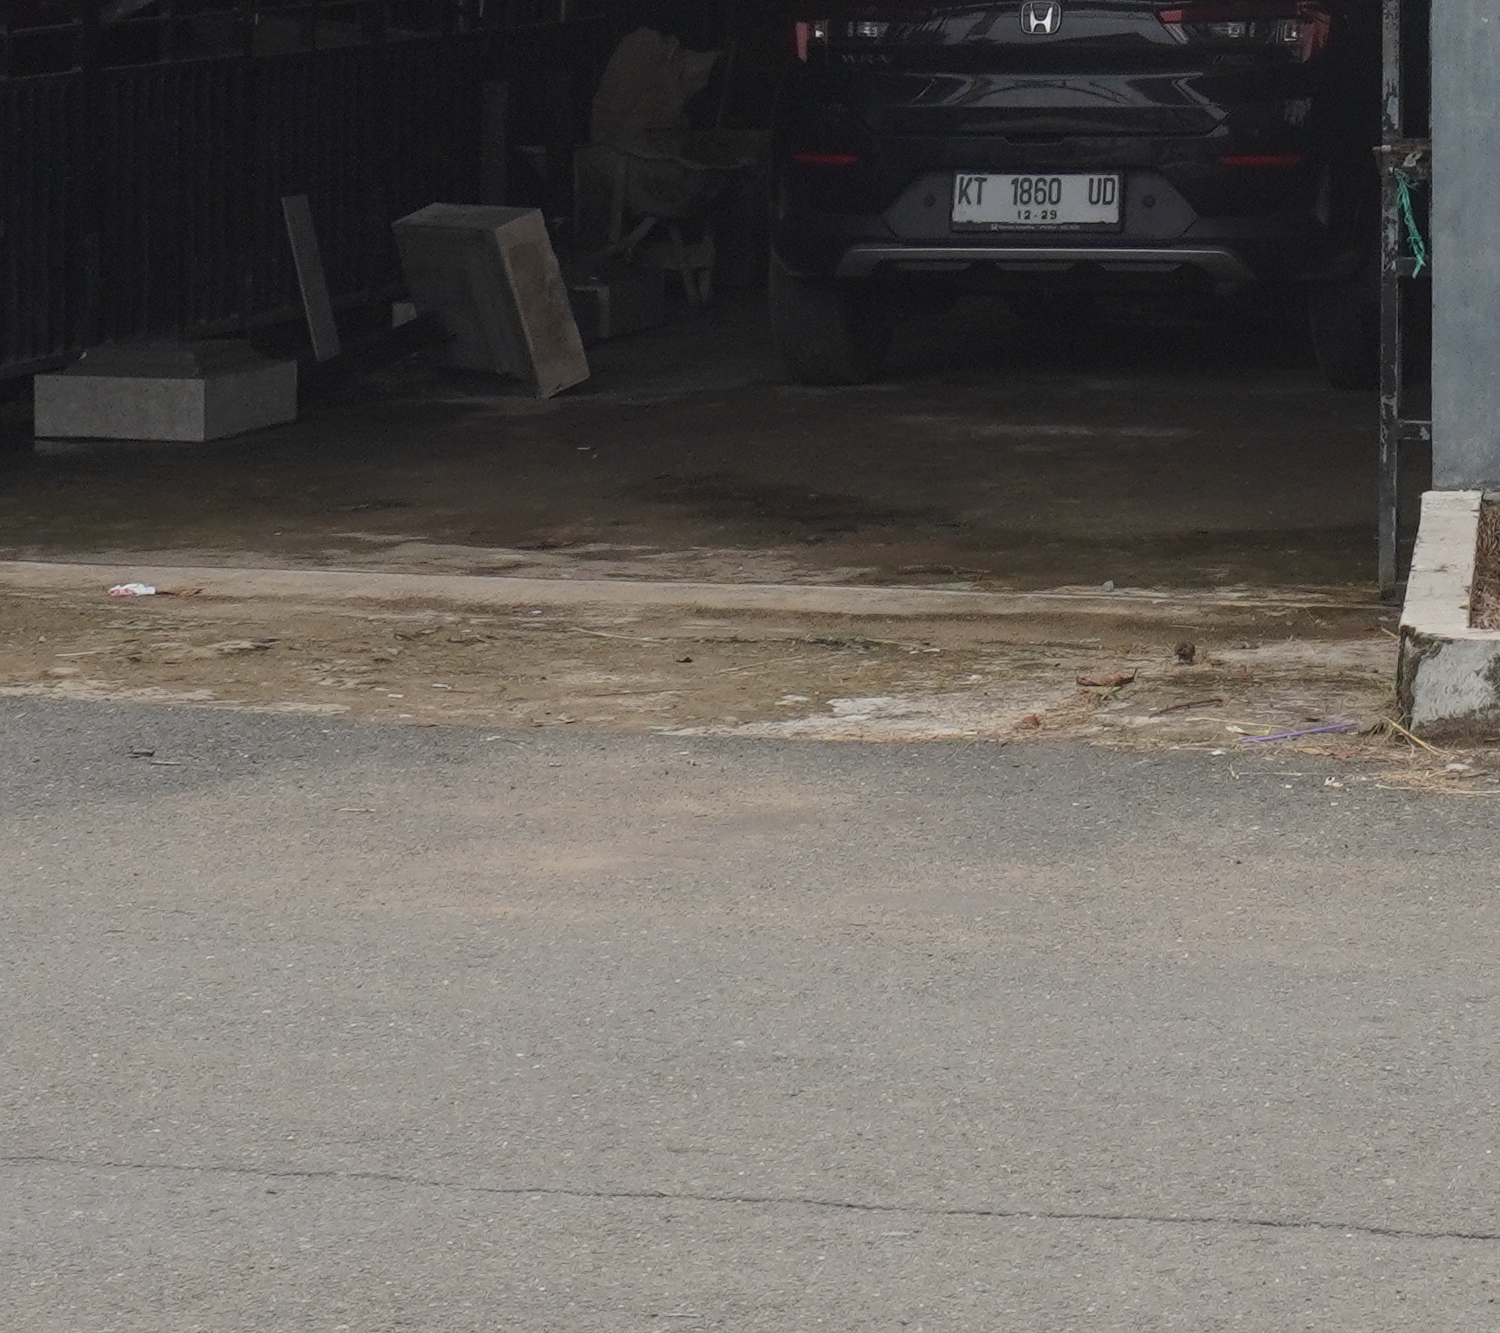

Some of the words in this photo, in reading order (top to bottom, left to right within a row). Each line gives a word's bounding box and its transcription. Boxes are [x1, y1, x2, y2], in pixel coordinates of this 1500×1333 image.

[957, 175, 988, 207] KT
[1010, 177, 1063, 207] 1860
[1087, 176, 1116, 207] UD
